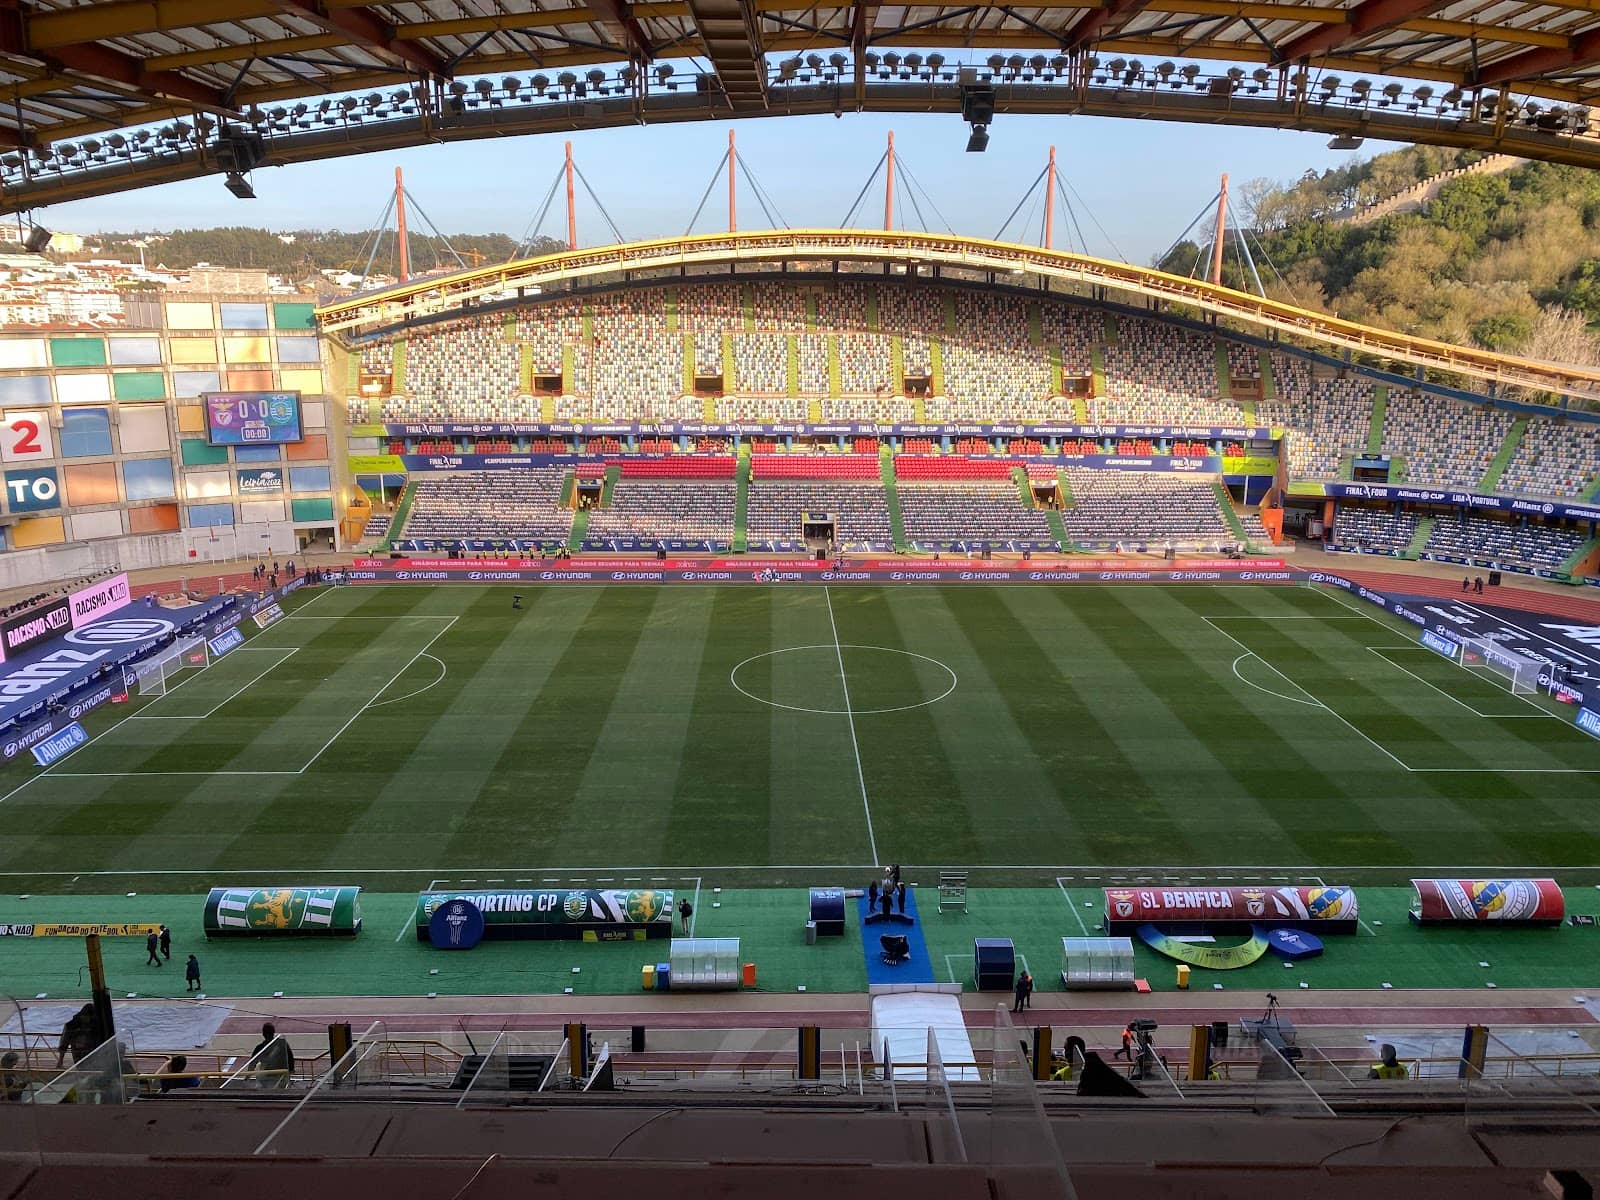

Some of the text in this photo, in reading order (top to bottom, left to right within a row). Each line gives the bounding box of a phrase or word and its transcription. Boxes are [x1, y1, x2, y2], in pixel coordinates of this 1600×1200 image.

[238, 399, 269, 418] 0 0
[10, 420, 42, 454] 2
[8, 477, 56, 503] TO
[1397, 490, 1420, 498] Allianz
[1512, 500, 1541, 511] Allianz
[1326, 576, 1352, 588] HYUNDAI
[76, 592, 106, 617] RACISMO
[7, 618, 46, 648] RACISMO
[82, 688, 111, 712] HYUNDAI
[1550, 680, 1584, 703] HYUNDAI
[1579, 711, 1600, 733] Allia
[18, 722, 53, 749] HYUNDAI
[40, 733, 76, 762] Allianz
[456, 894, 558, 912] PORTING CP
[1140, 891, 1232, 909] SL BENFICA
